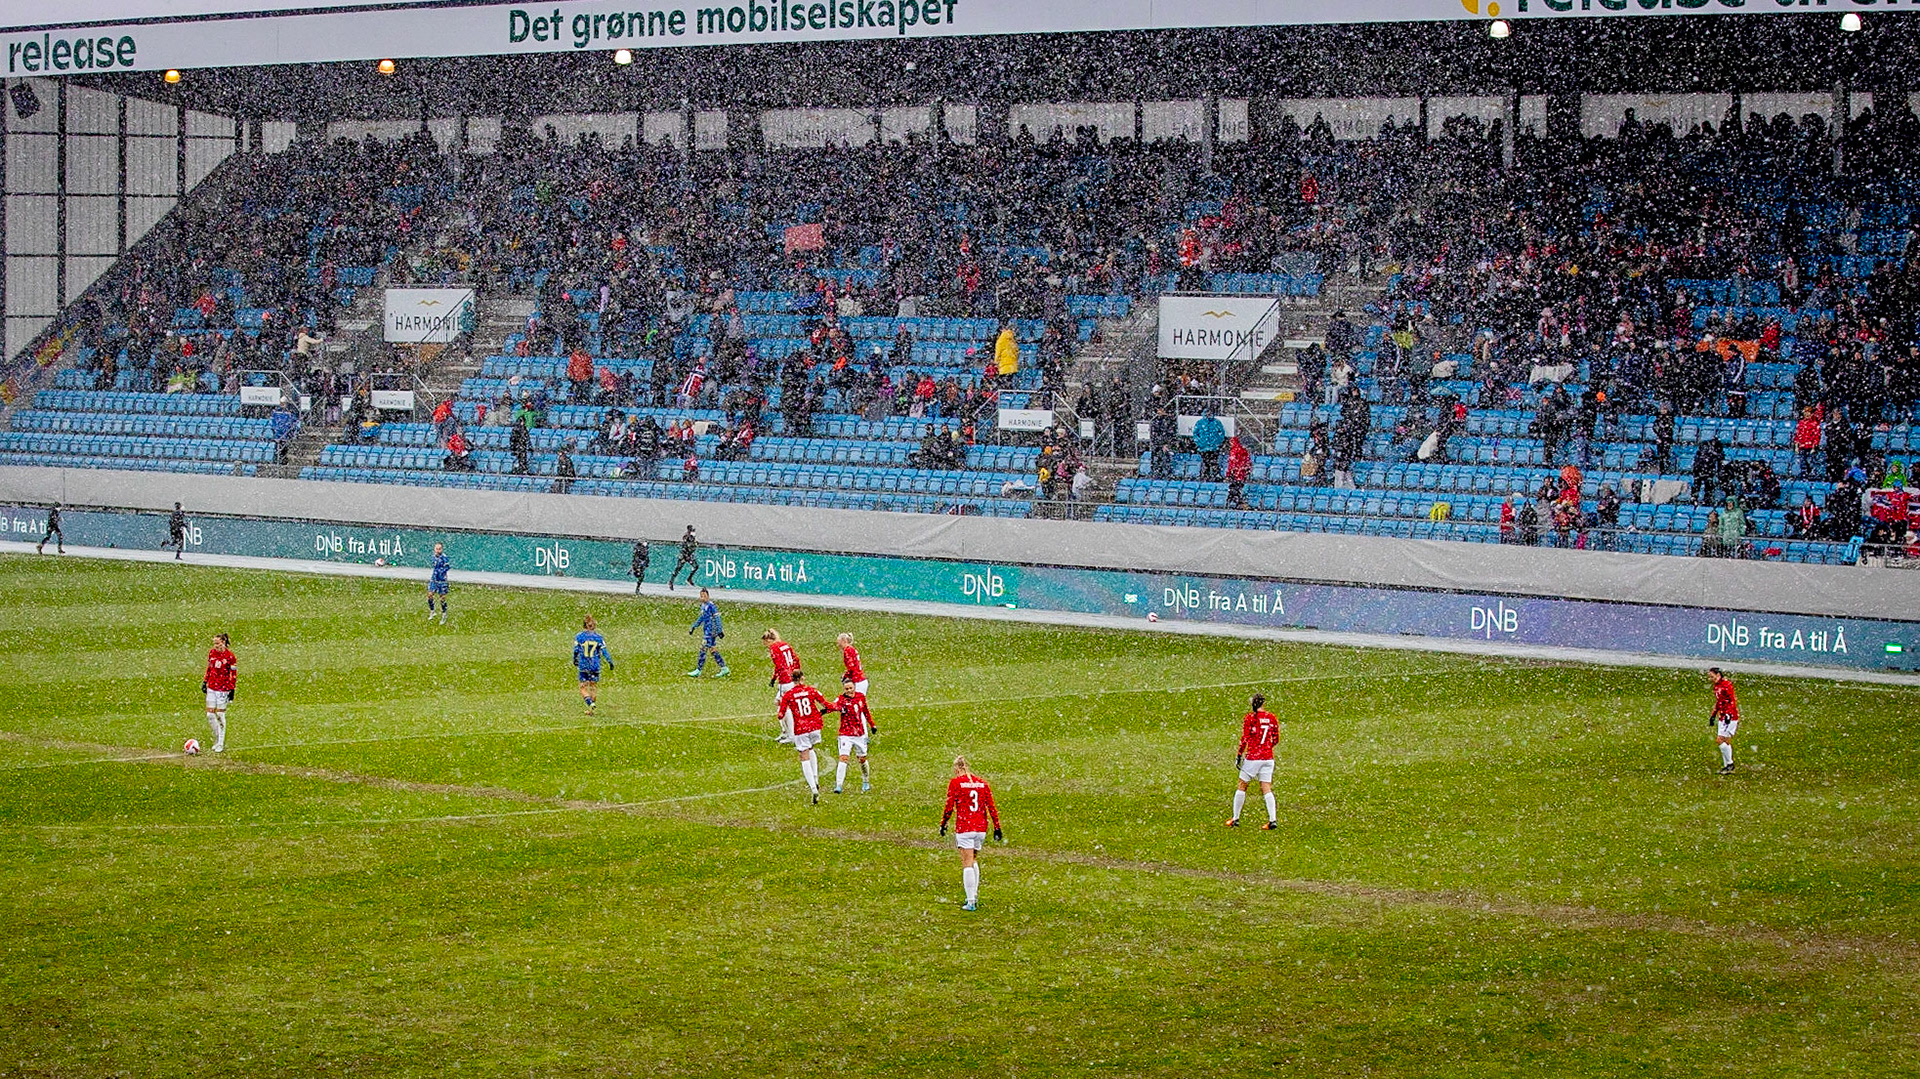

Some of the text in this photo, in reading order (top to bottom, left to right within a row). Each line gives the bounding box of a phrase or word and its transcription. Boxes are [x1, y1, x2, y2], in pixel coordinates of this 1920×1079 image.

[510, 0, 958, 49] Det grønne mobilselskapet
[9, 33, 137, 73] release
[1008, 419, 1042, 428] HARMONIE
[13, 517, 27, 533] fra
[29, 518, 37, 534] A
[39, 520, 49, 534] ti
[182, 520, 203, 551] NB
[316, 530, 404, 557] DNB fra A til Å
[535, 542, 570, 575] DNB
[705, 554, 807, 584] DNB fra A til Å
[963, 567, 1004, 604] DNB
[1163, 582, 1285, 615] DNB fra A til Å
[1470, 600, 1519, 639] DNB
[582, 640, 598, 658] 17
[1707, 617, 1847, 654] DNB fra A til Å
[782, 649, 794, 668] 14
[795, 697, 812, 718] 18
[1260, 724, 1270, 745] 7
[969, 789, 979, 812] 3
